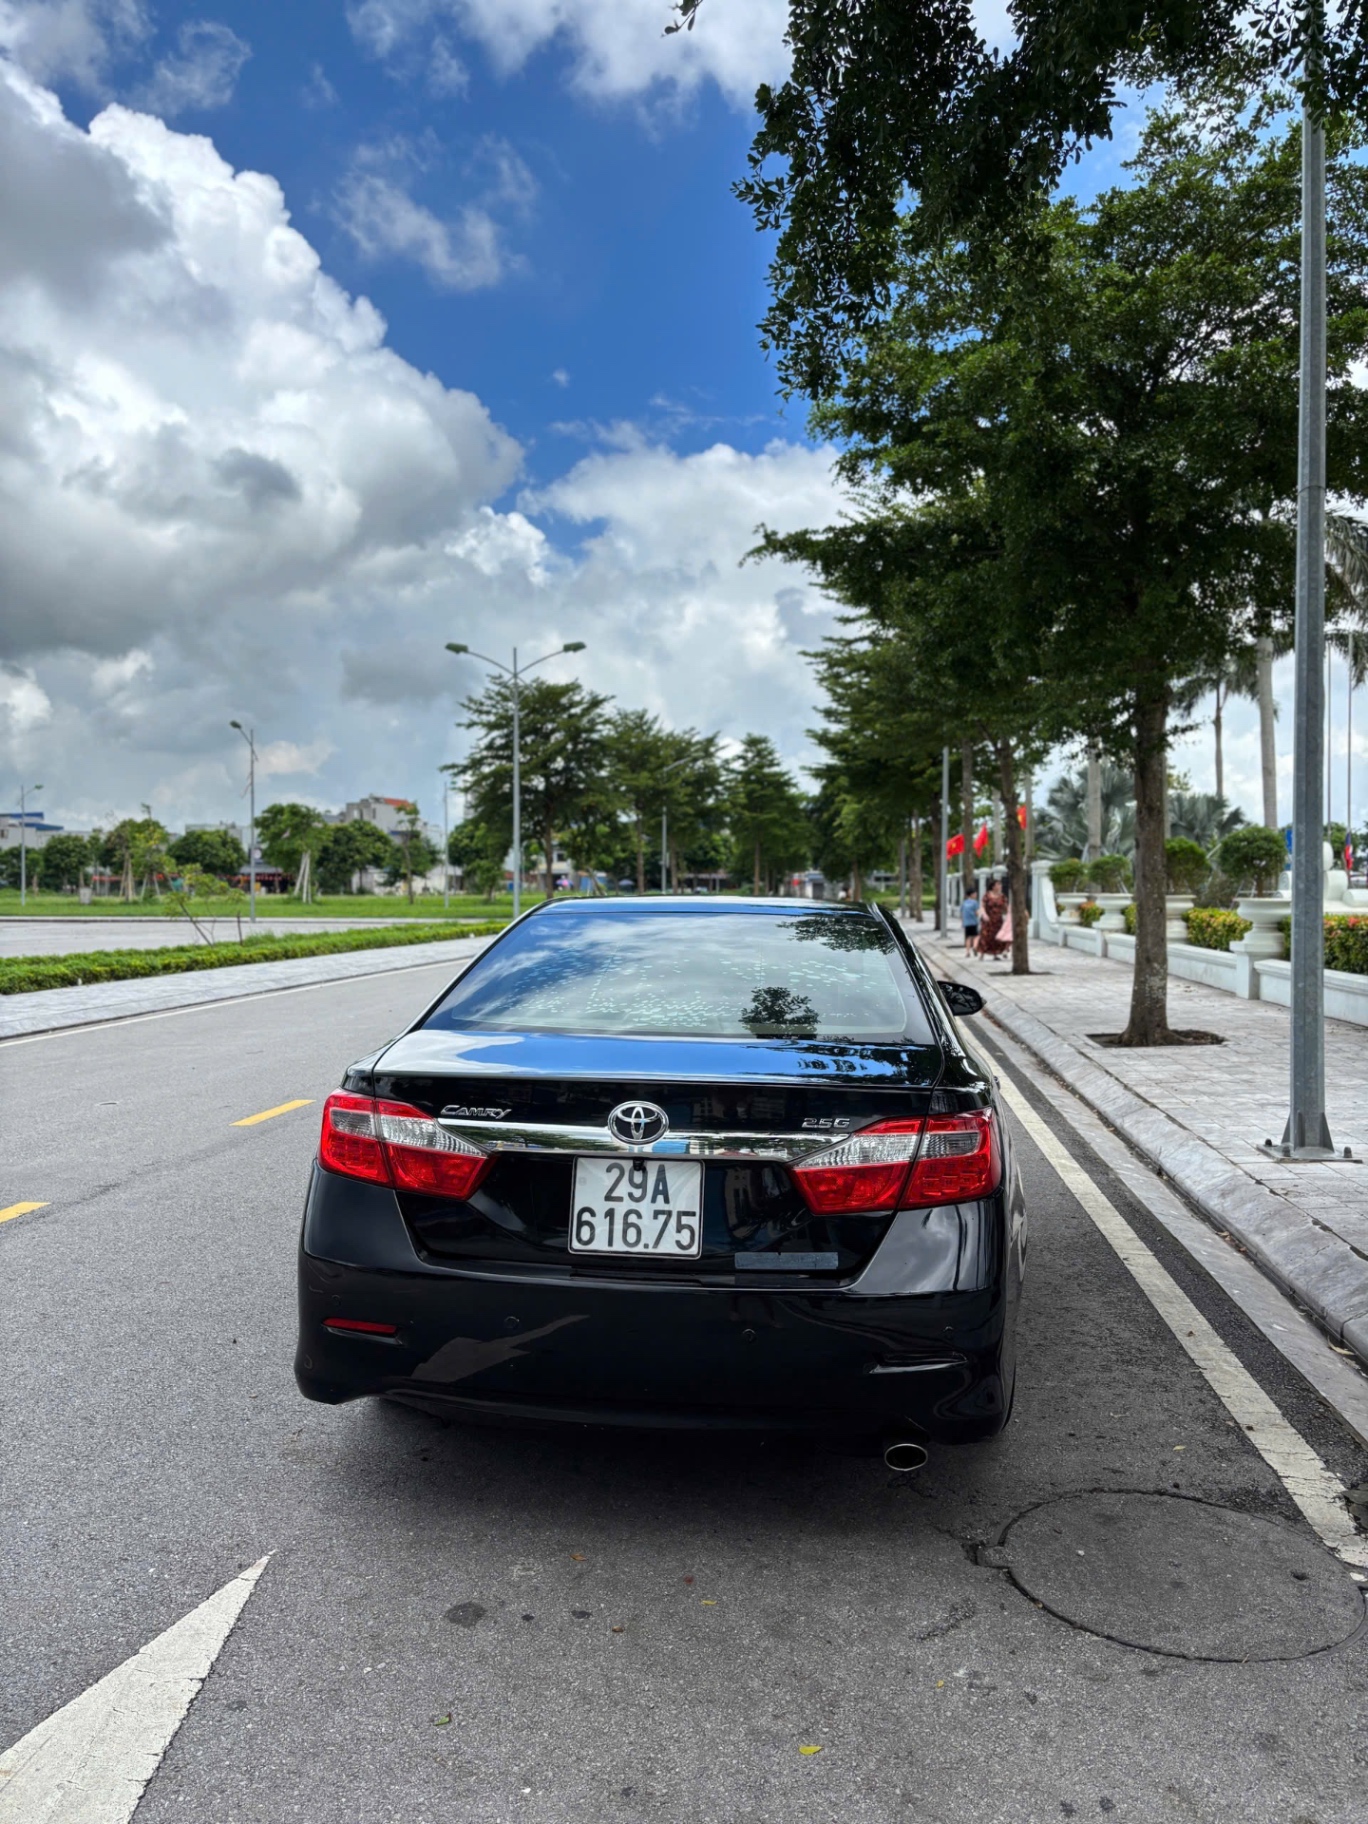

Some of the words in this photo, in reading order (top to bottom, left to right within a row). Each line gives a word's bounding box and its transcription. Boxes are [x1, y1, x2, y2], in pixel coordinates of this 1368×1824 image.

[440, 1104, 512, 1120] CAMRY
[604, 1162, 670, 1205] 29A
[575, 1206, 697, 1251] 616.75
